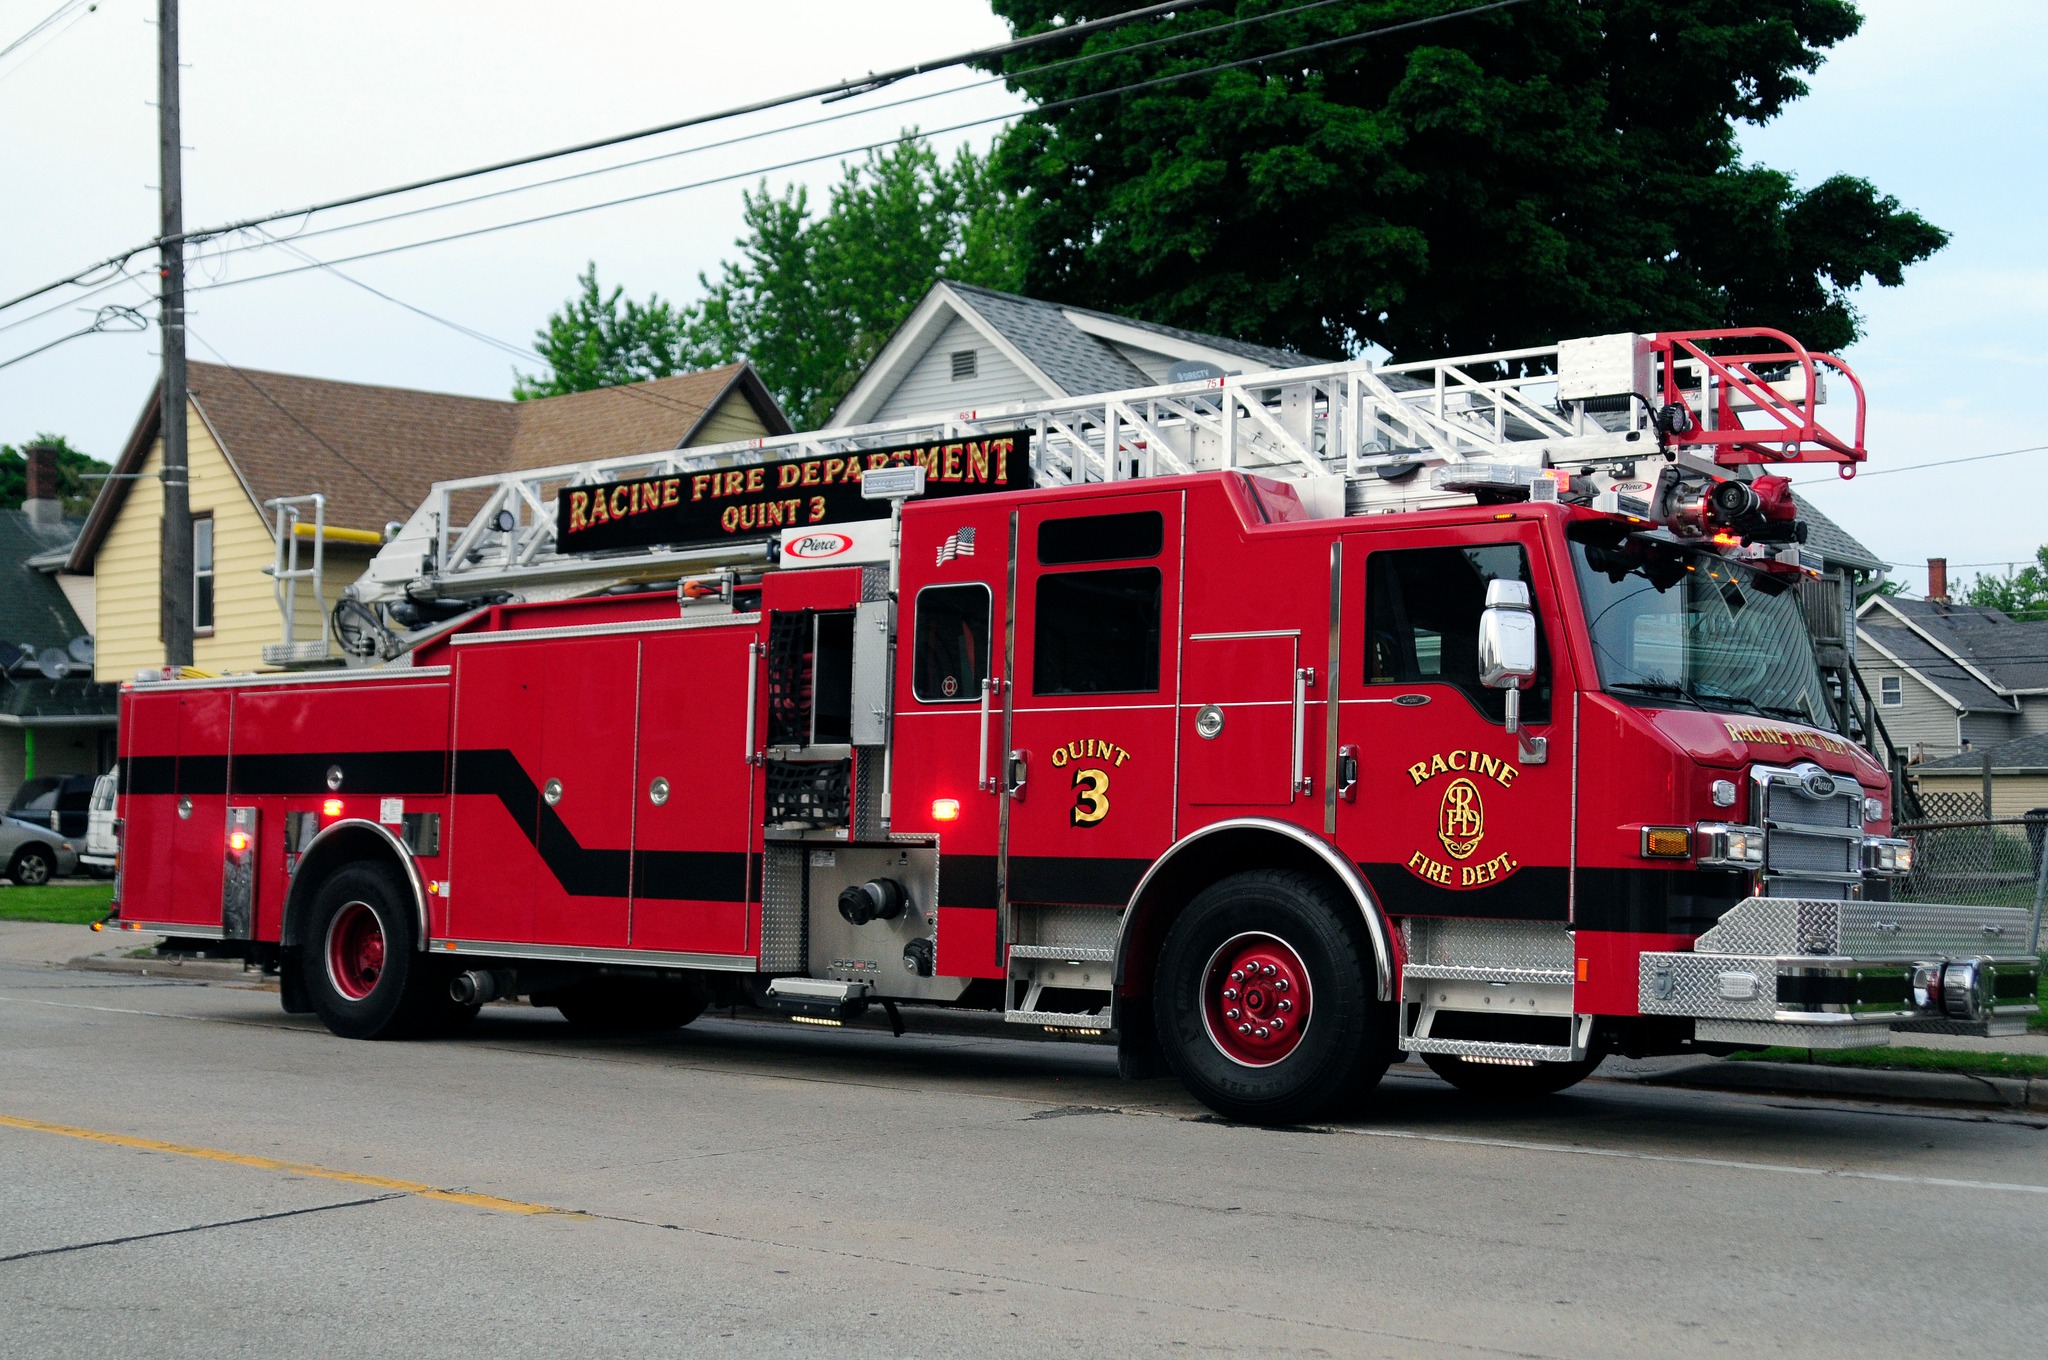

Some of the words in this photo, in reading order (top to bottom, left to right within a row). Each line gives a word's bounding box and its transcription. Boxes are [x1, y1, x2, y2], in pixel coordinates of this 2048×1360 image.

[1207, 379, 1217, 388] 75
[568, 478, 681, 534] RACINE
[691, 467, 766, 503] FIRE
[1619, 483, 1643, 492] Pierce
[721, 498, 802, 533] QUINT
[809, 495, 826, 524] 3
[799, 538, 836, 554] Pierce
[1723, 722, 1789, 746] RACINE
[1788, 728, 1821, 750] FIRE
[1052, 738, 1131, 769] QUINT
[1407, 749, 1519, 789] RACINE
[1070, 768, 1111, 829] 3
[1812, 776, 1832, 792] Pierce
[1407, 849, 1453, 886] FIRE
[1461, 851, 1518, 887] DEPT.
